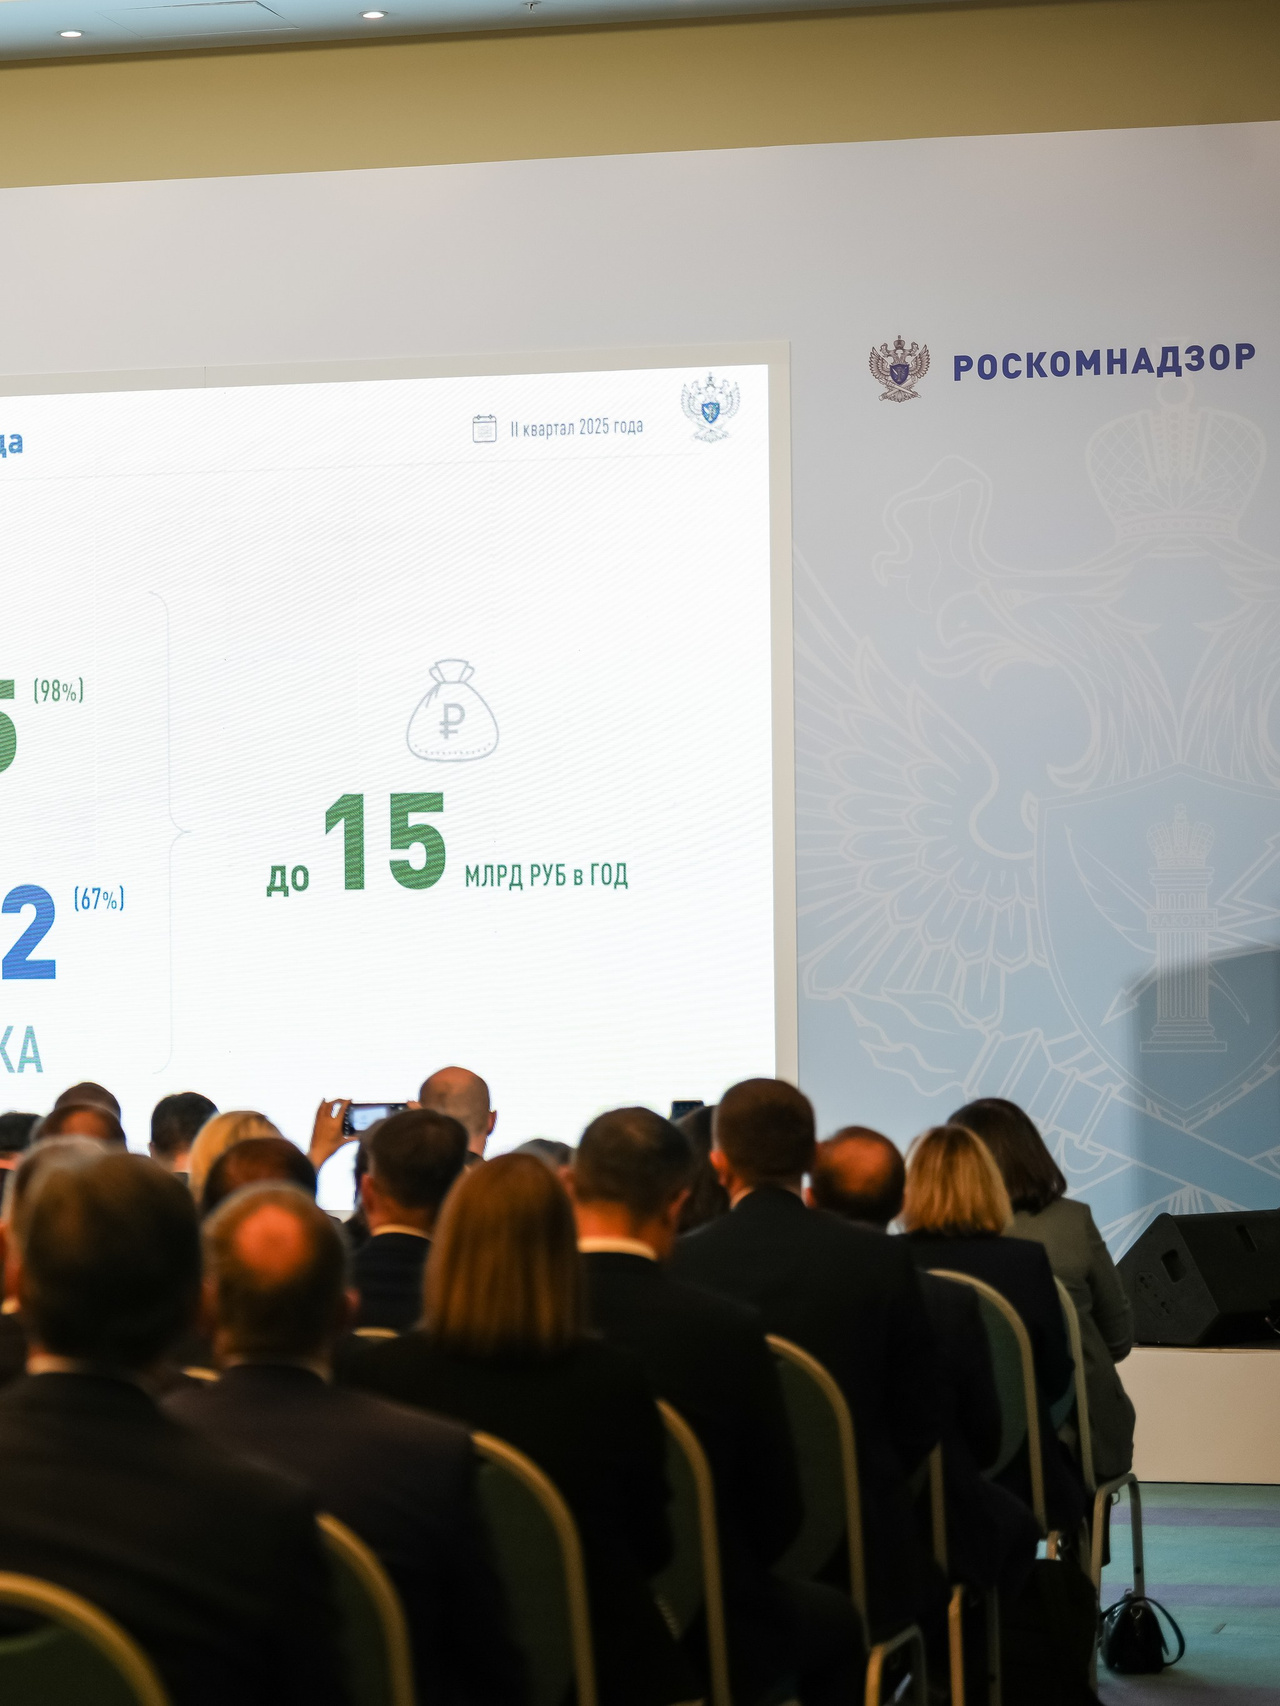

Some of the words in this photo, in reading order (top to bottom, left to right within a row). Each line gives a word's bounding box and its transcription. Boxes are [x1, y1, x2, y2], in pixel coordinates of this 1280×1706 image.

[953, 342, 1257, 382] РОСКОМНАДЗОР
[523, 421, 575, 440] квартал
[579, 417, 610, 436] 2025
[613, 419, 644, 436] года
[34, 676, 84, 704] (98%)
[266, 864, 310, 897] до
[325, 791, 447, 890] 15
[465, 864, 523, 891] МЛРД
[530, 863, 567, 887] РУБ
[590, 862, 628, 889] ГОД
[74, 884, 124, 912] (67%)
